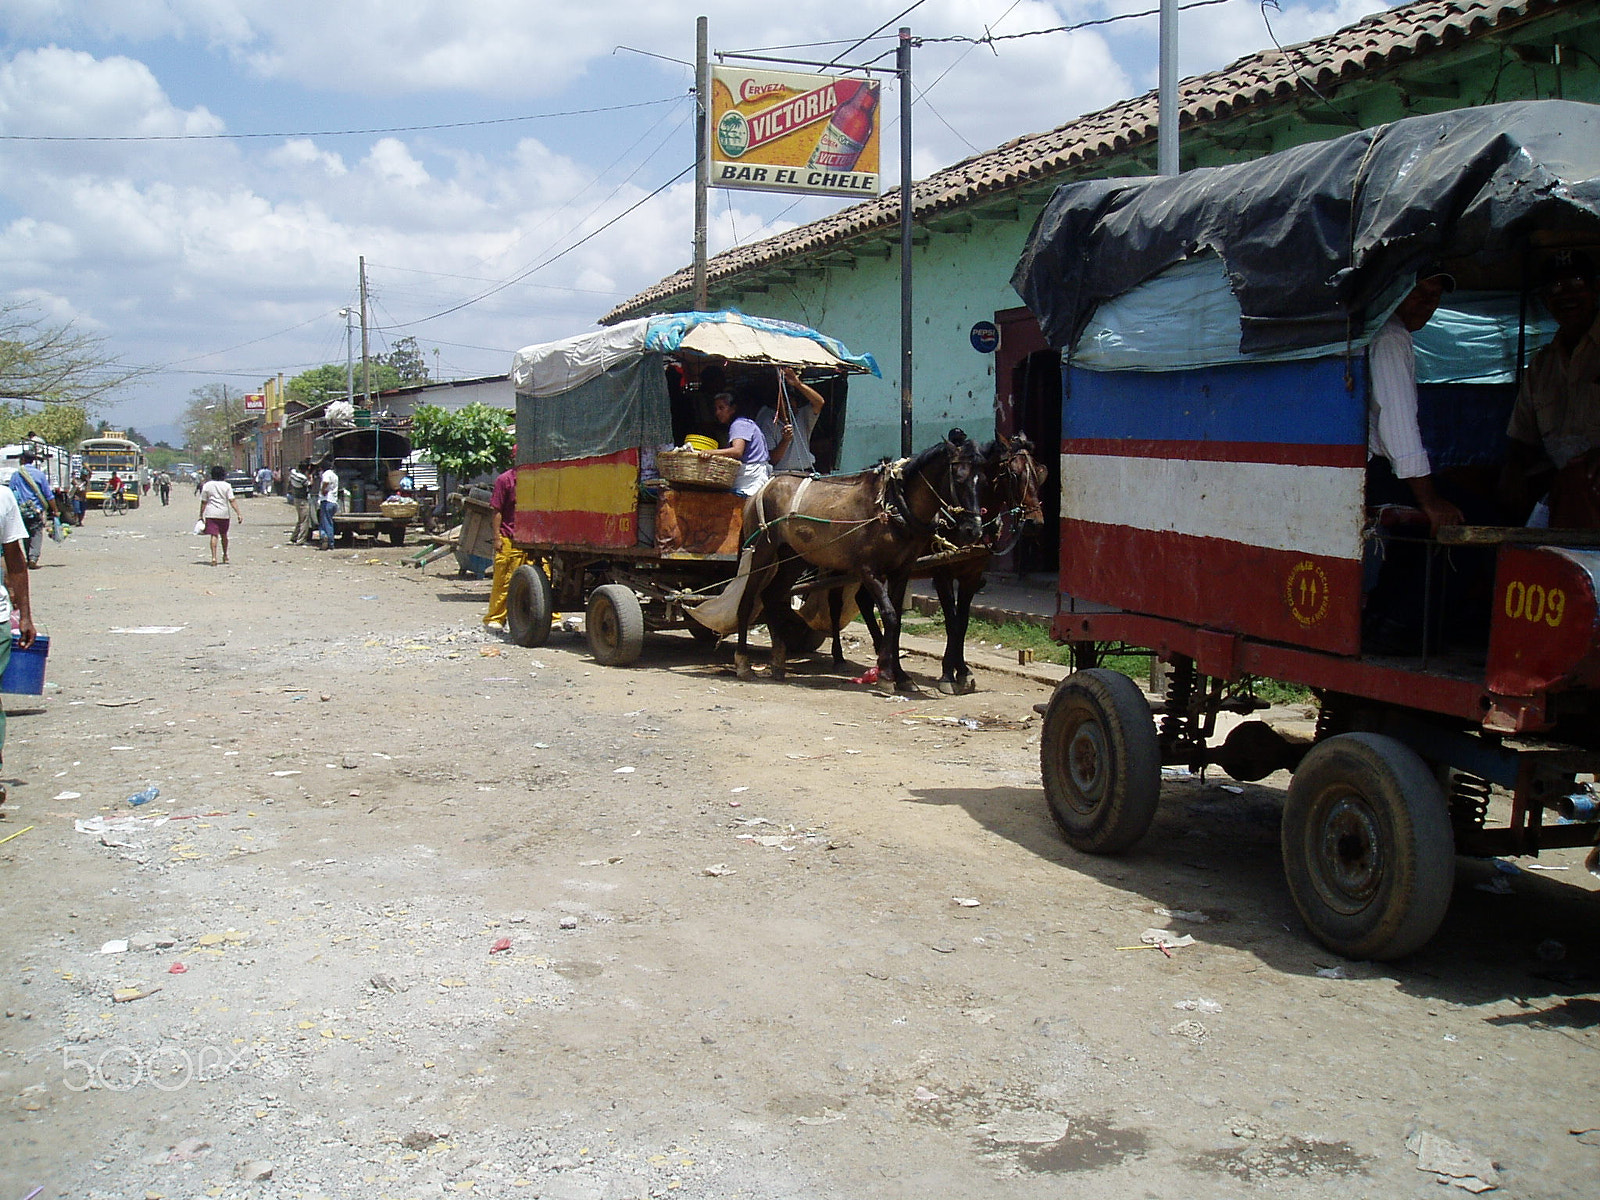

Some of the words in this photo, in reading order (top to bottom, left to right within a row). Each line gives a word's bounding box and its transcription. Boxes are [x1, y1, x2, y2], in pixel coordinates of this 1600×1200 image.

[740, 79, 786, 102] CERVEZA
[752, 86, 838, 141] VICTORIA
[721, 165, 767, 181] BAR
[774, 169, 799, 184] EL
[807, 172, 874, 189] CHELE
[972, 328, 995, 336] PEPSI
[1505, 581, 1565, 627] 009
